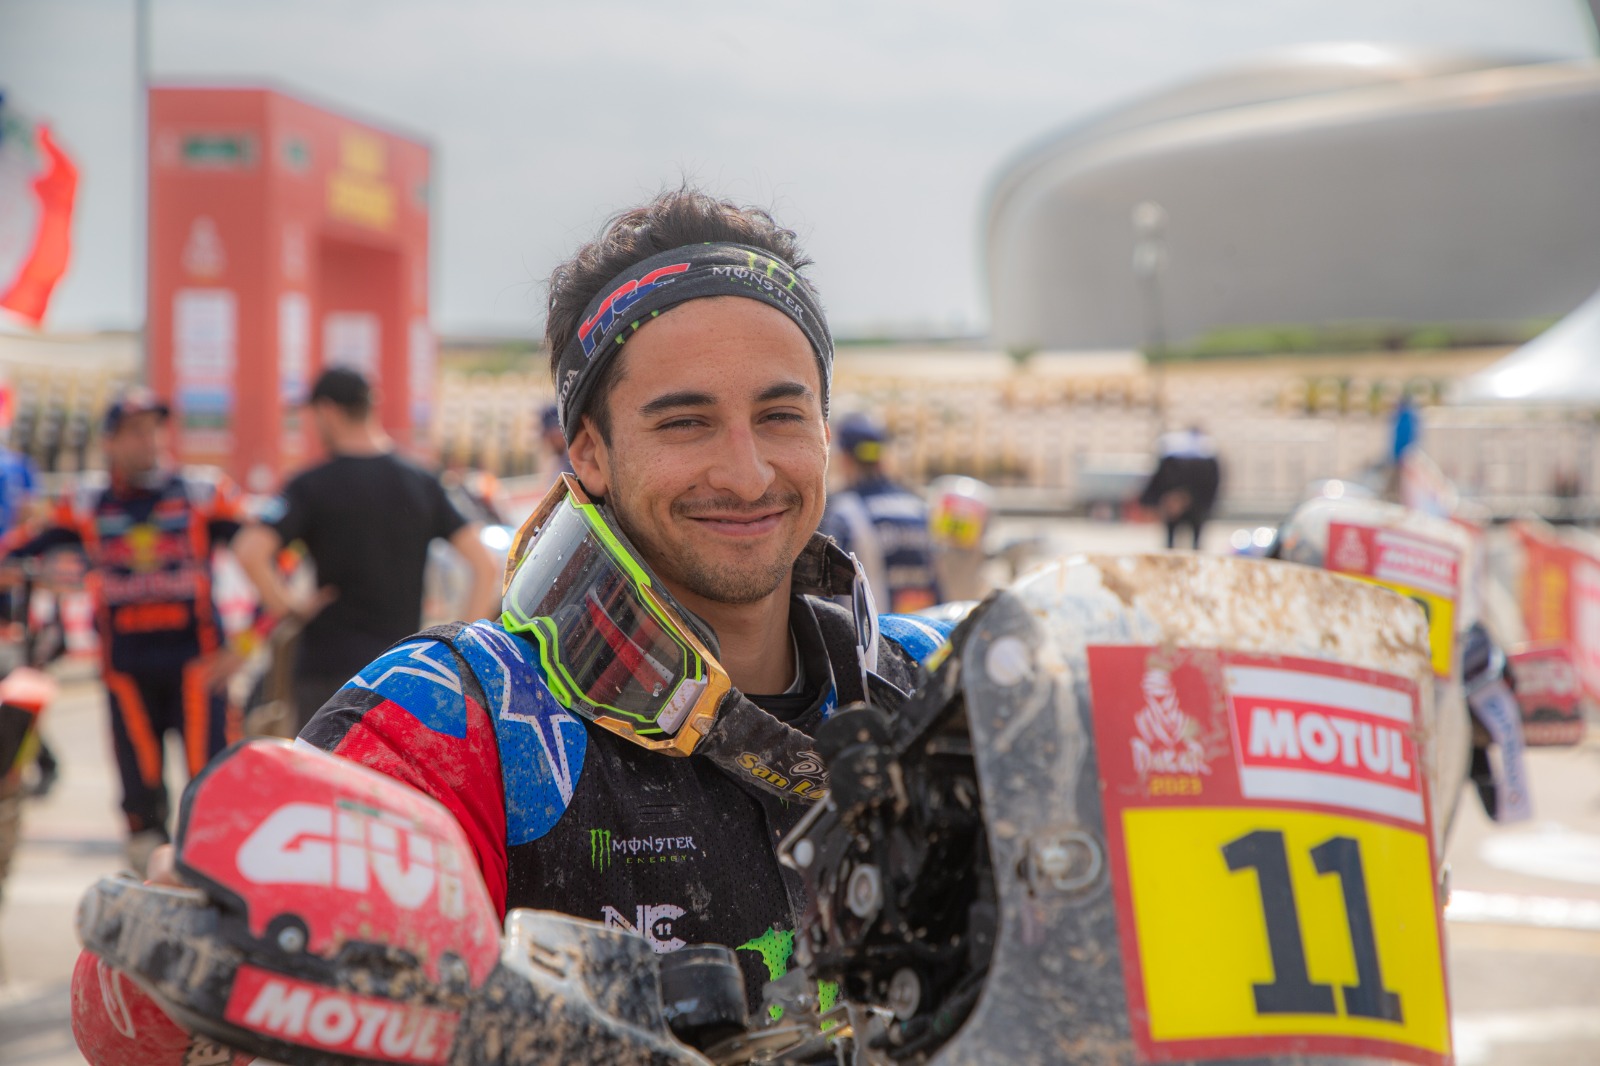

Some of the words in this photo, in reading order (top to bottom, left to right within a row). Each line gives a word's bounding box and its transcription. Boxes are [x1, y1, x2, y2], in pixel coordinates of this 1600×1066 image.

[578, 262, 691, 358] HRC
[712, 266, 805, 319] MONSTER
[1249, 707, 1411, 780] MOTUL
[735, 751, 790, 789] San
[1150, 775, 1202, 796] 2023
[612, 836, 697, 855] MONSTER
[626, 855, 687, 864] ENERGY
[655, 923, 672, 936] 11
[1220, 828, 1406, 1026] 11
[245, 979, 439, 1058] MOTUL
